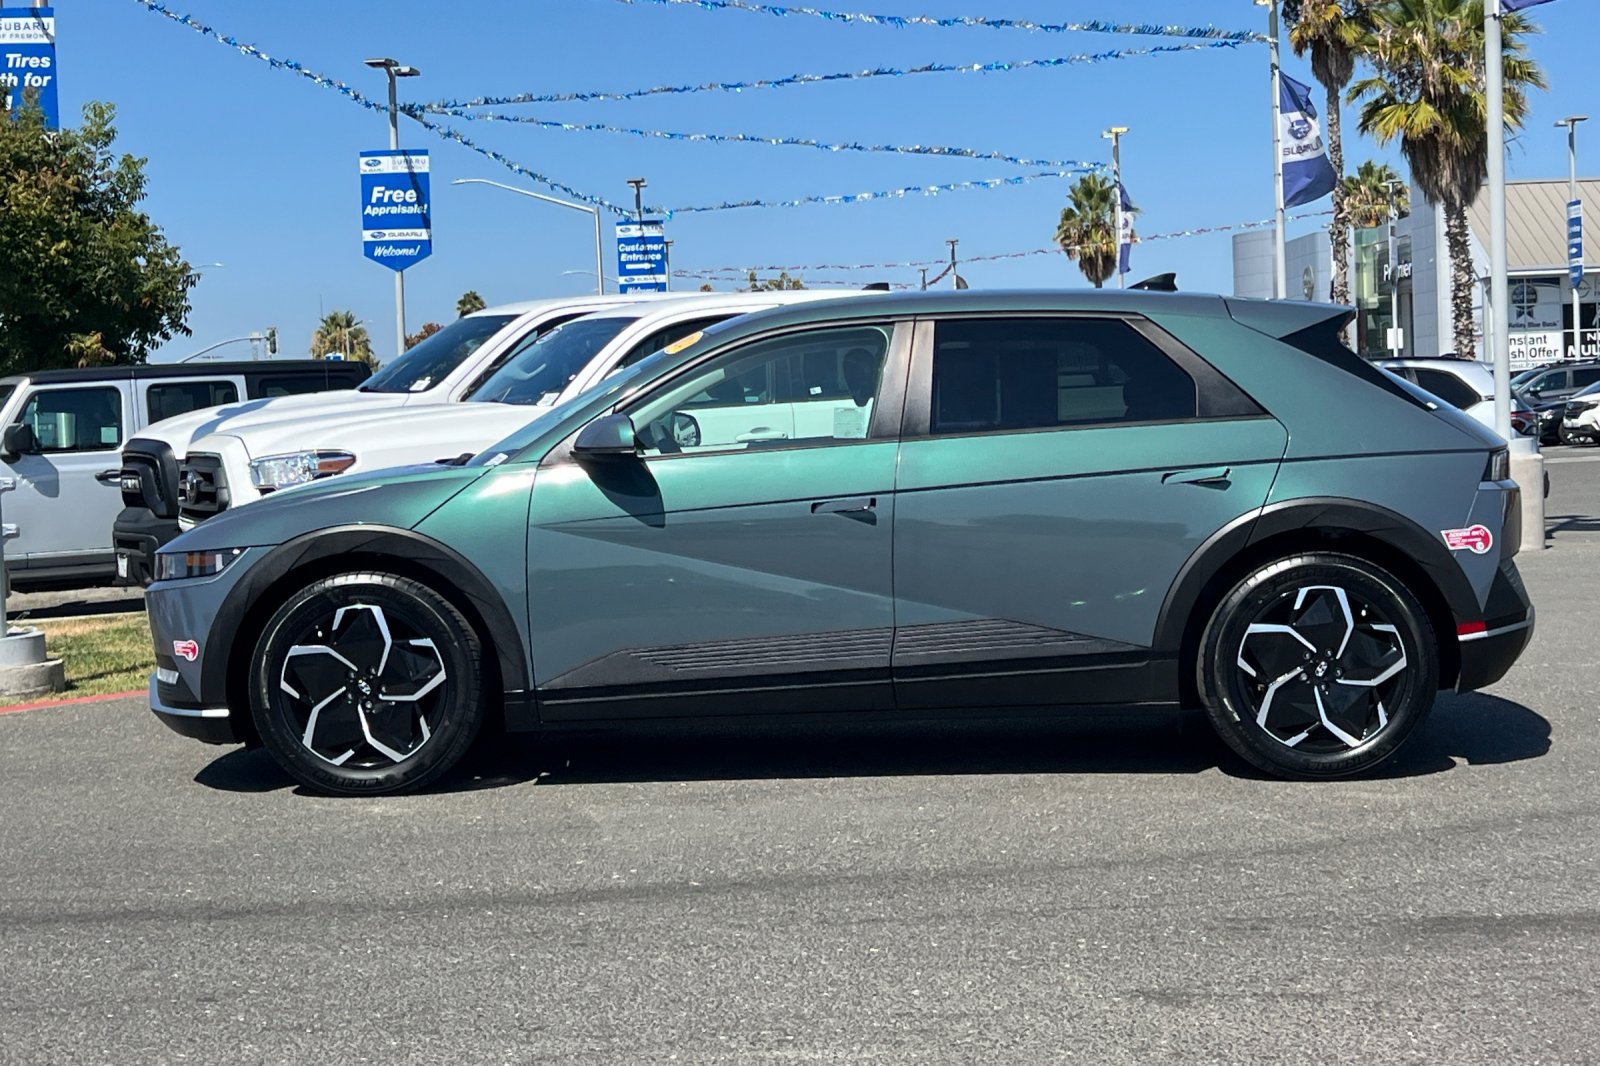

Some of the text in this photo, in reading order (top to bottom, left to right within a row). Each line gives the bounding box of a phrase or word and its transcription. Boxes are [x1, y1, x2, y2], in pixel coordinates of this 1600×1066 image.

[6, 53, 51, 68] Tires
[24, 72, 52, 87] for
[371, 186, 417, 203] Free
[364, 203, 428, 217] Appraisals!
[373, 245, 421, 257] Welcome!
[618, 243, 664, 252] Customer
[620, 253, 662, 262] Entrance
[1383, 260, 1412, 282] Prmier
[1510, 347, 1559, 359] sh Offer
